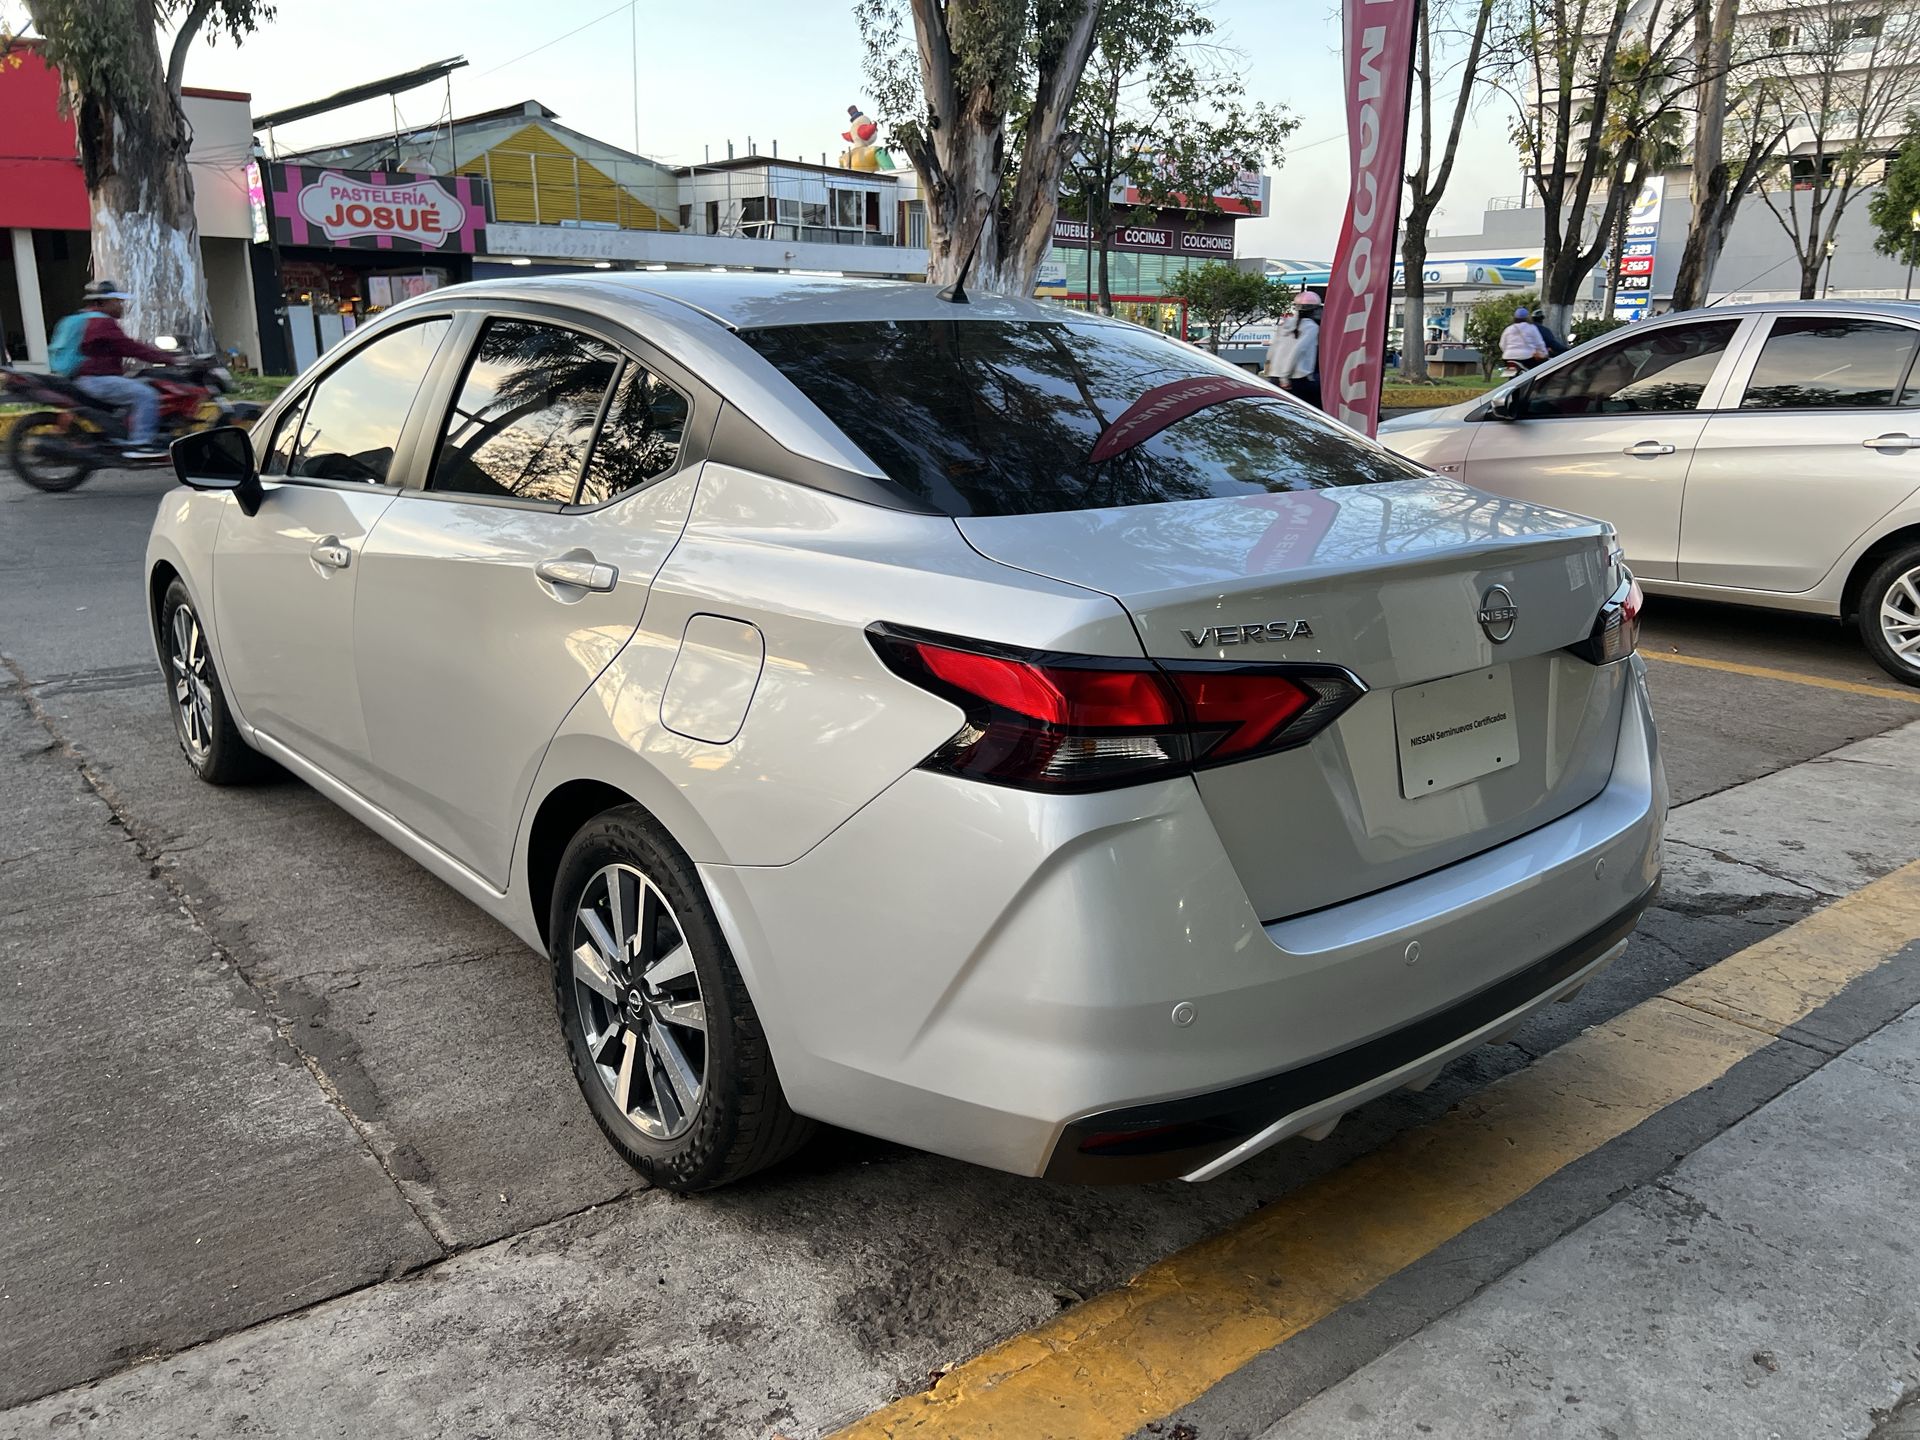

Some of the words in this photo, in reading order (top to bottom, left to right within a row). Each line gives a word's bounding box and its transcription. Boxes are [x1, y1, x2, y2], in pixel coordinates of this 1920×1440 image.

[330, 185, 428, 207] PASTELERÍA
[325, 203, 442, 233] JOSUÉ
[1124, 230, 1166, 245] COCINAS
[1183, 235, 1232, 250] COLCHONES
[1180, 619, 1316, 648] VERSA
[1410, 732, 1435, 747] NISSAN
[1436, 722, 1473, 740] Seminuevos
[1474, 712, 1507, 728] Certificados
